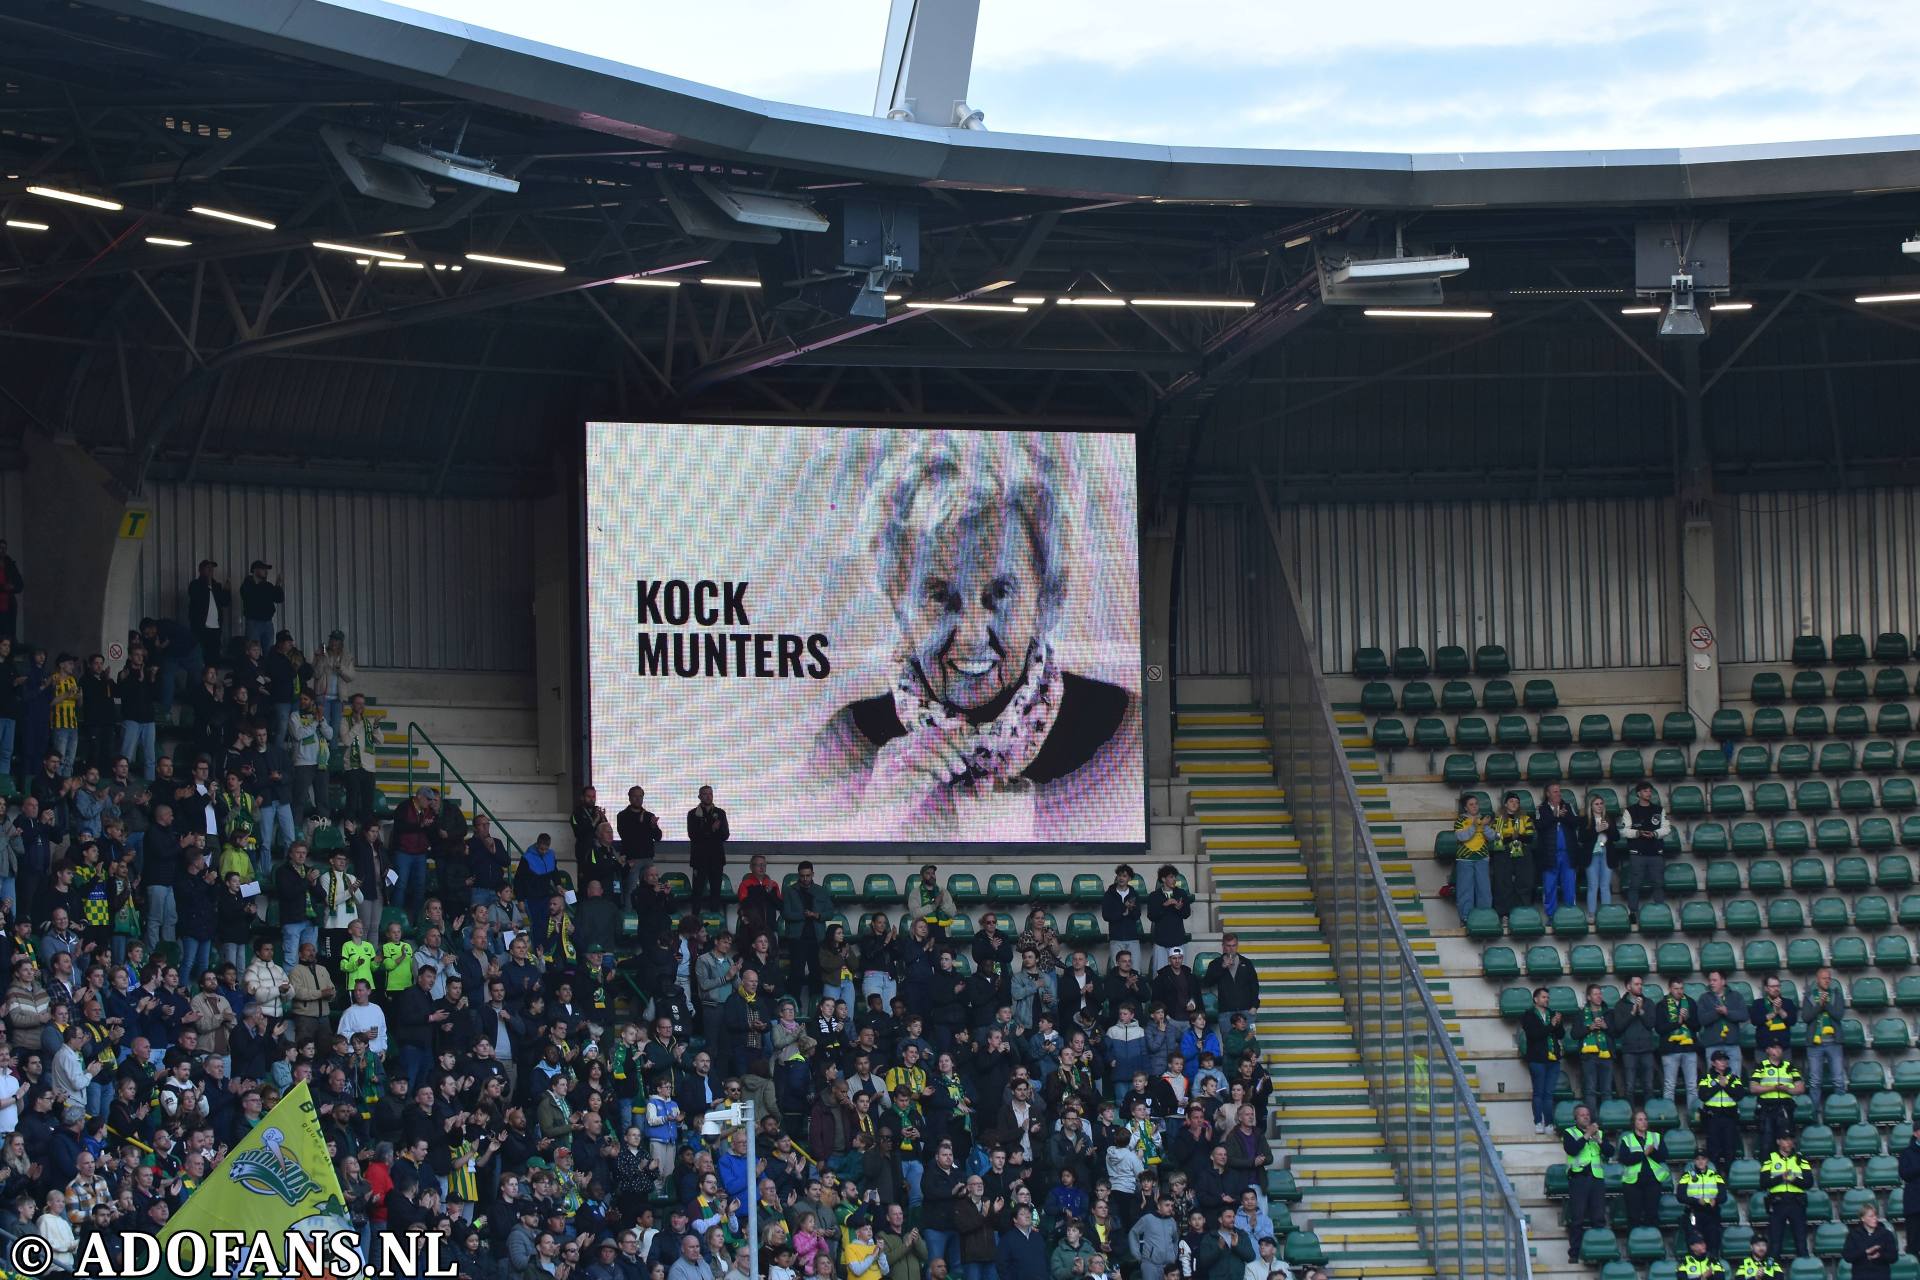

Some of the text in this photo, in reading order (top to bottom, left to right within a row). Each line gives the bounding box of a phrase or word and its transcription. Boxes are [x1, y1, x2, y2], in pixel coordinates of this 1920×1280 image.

[128, 512, 145, 536] T
[638, 580, 749, 626] KOCK
[639, 633, 831, 679] MUNTERS
